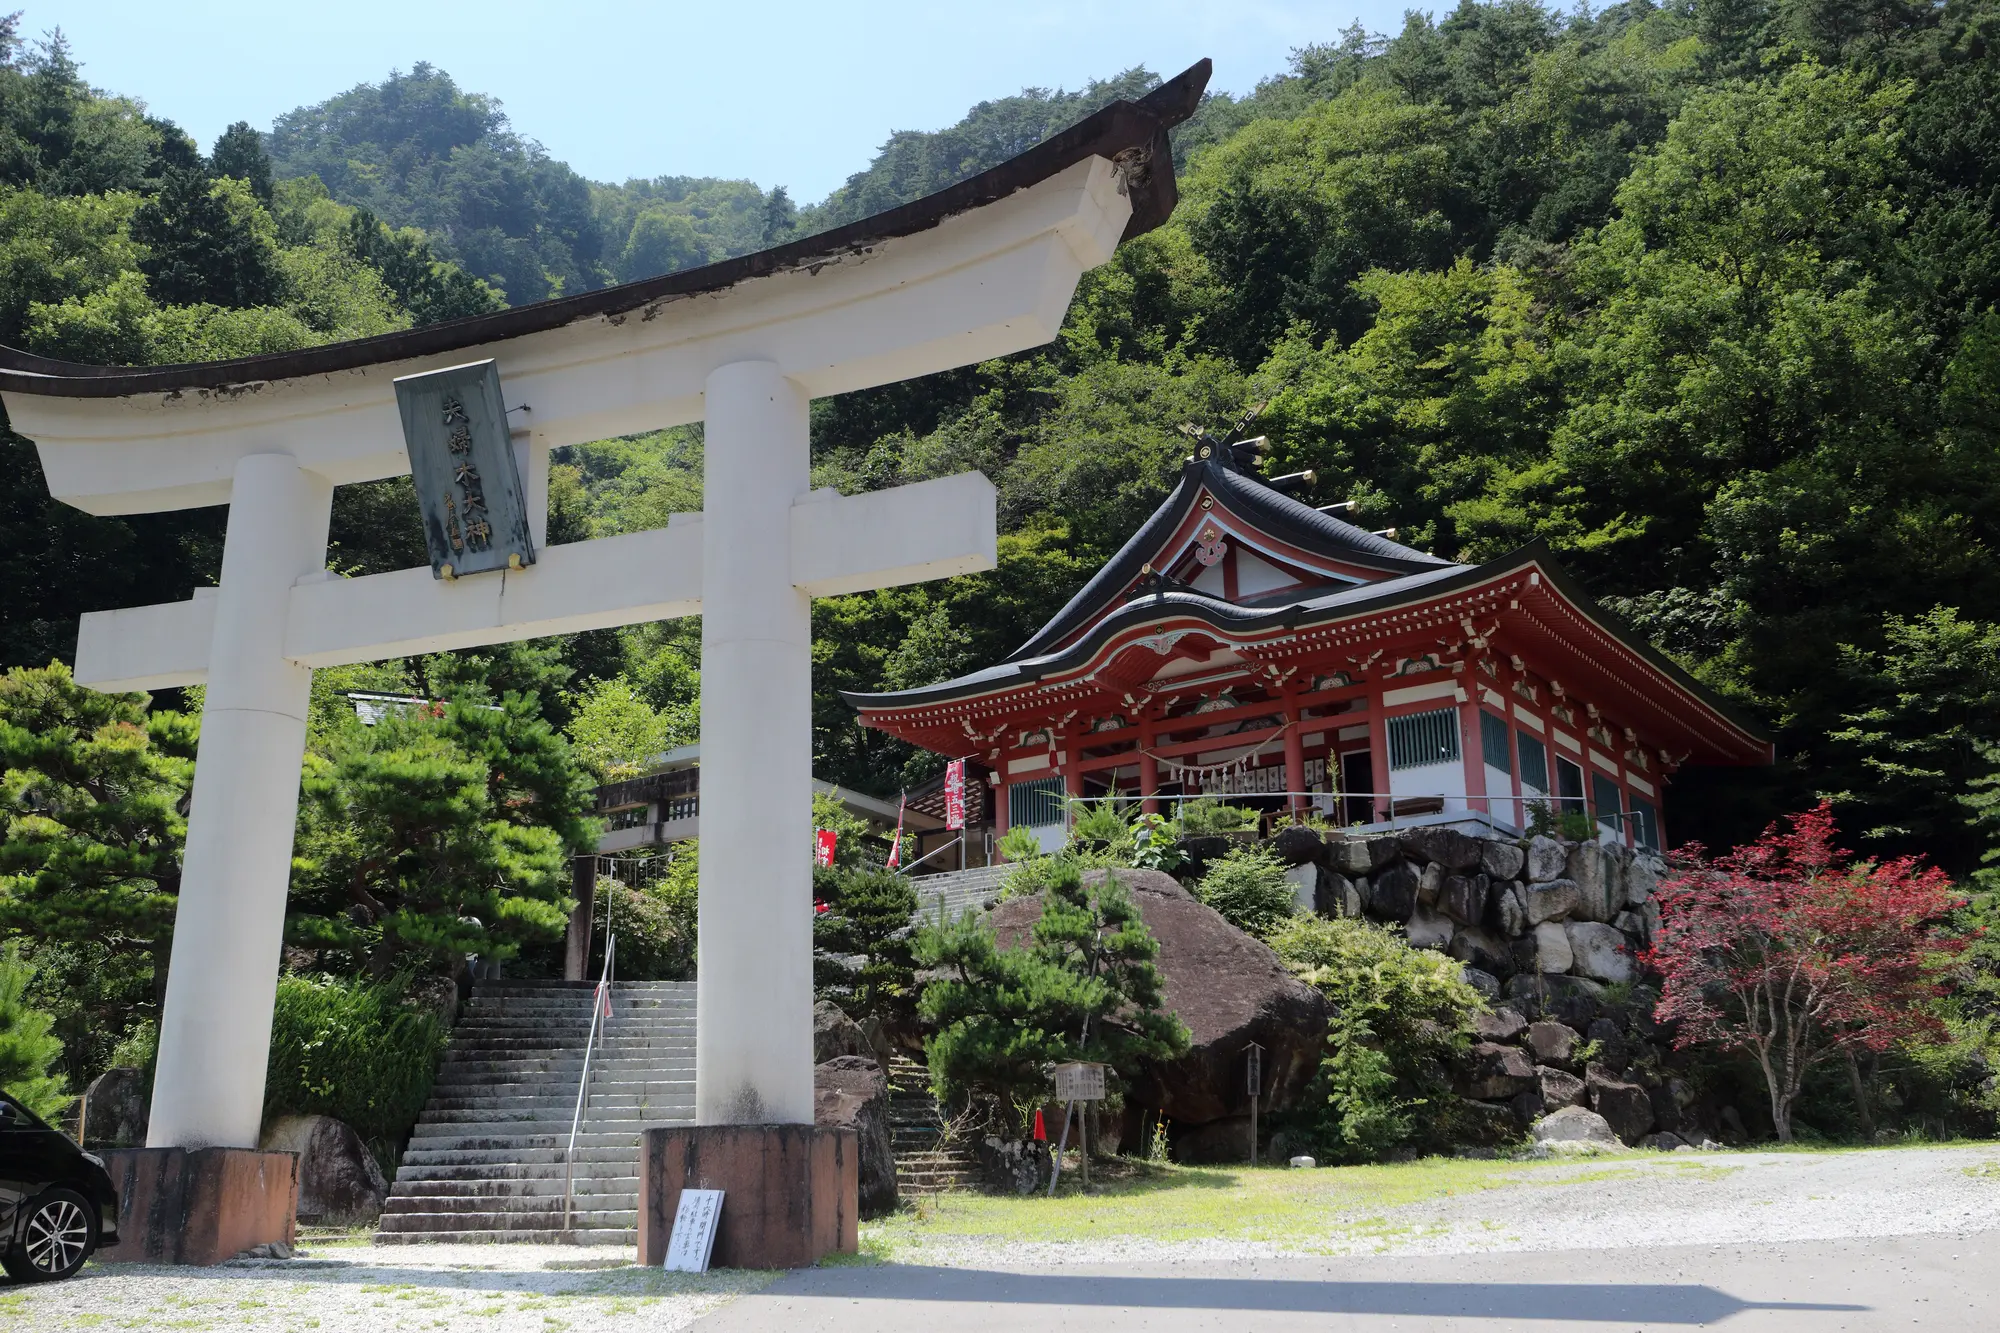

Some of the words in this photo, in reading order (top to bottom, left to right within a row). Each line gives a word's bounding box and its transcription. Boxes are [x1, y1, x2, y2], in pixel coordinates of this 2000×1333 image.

[442, 397, 492, 548] 夫婦木大神
